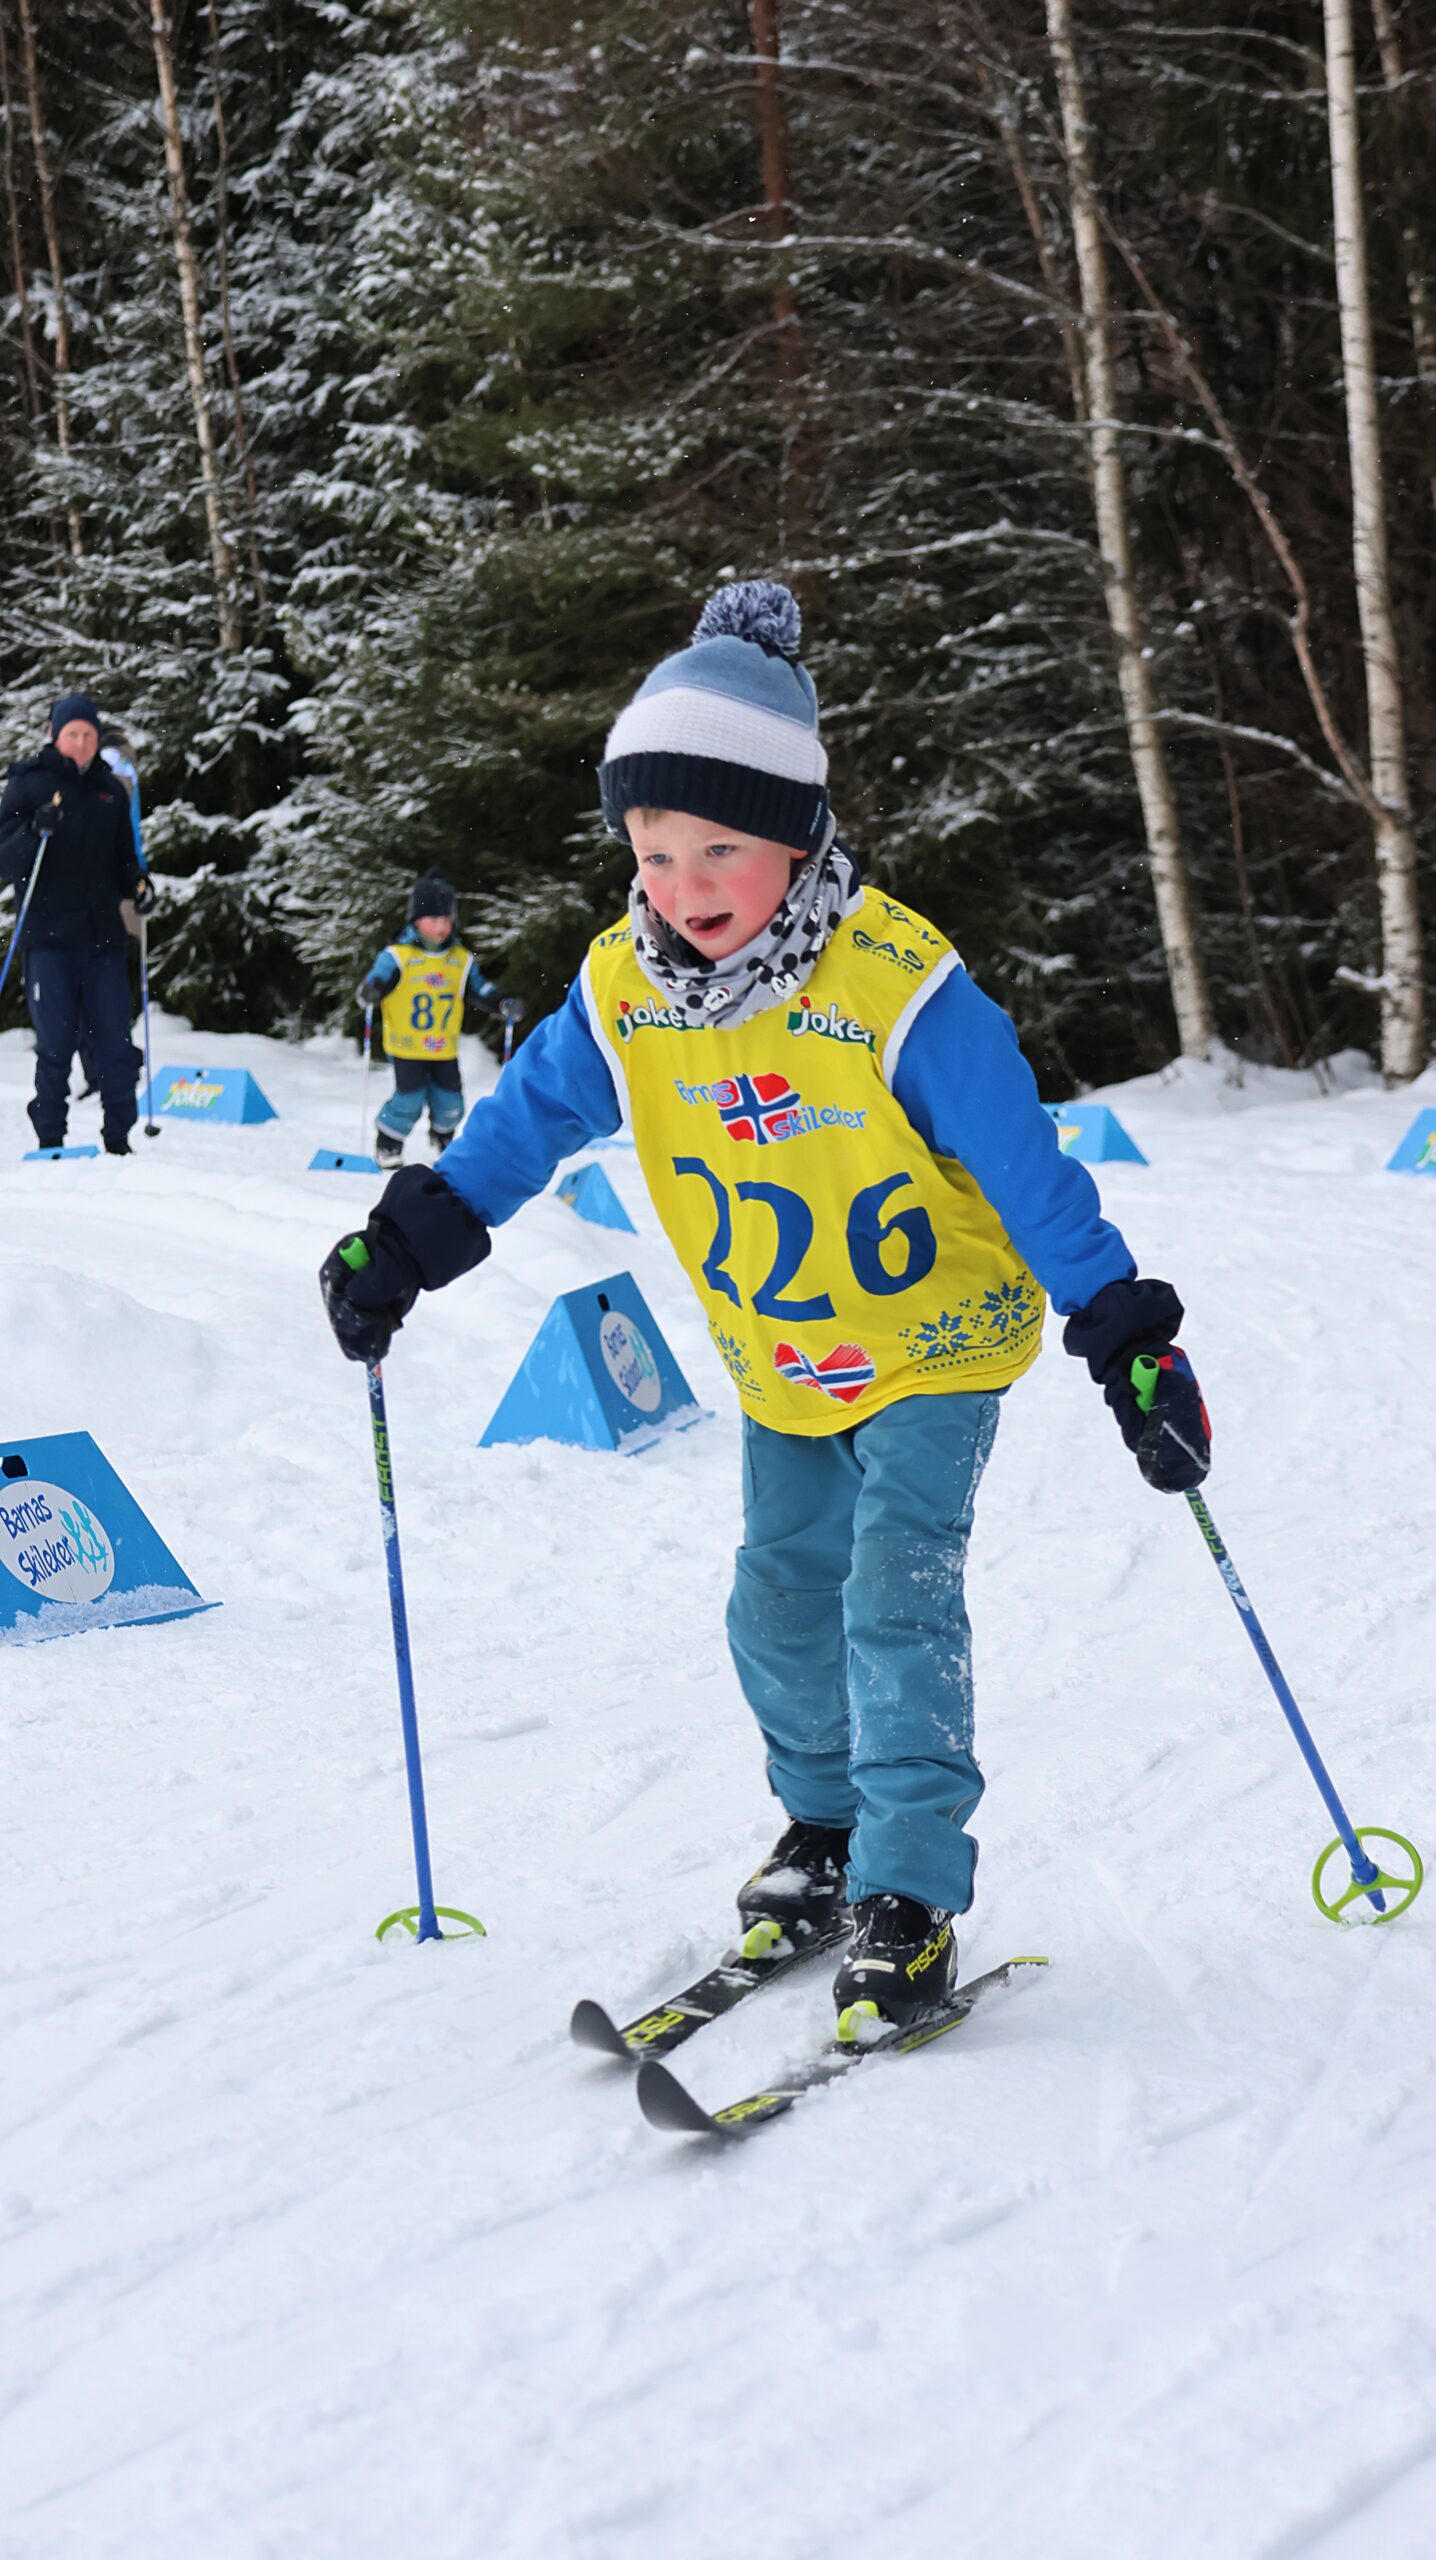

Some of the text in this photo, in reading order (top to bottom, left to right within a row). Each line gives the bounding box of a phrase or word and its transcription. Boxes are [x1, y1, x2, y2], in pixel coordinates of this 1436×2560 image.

[853, 930, 924, 971] GAS
[411, 992, 455, 1031] 87
[618, 997, 686, 1045] joke
[792, 995, 873, 1045] joker
[671, 1156, 938, 1323] 226
[0, 1494, 53, 1540] Barnas
[17, 1535, 76, 1587] Skileker
[905, 1920, 952, 1983] FISCHER
